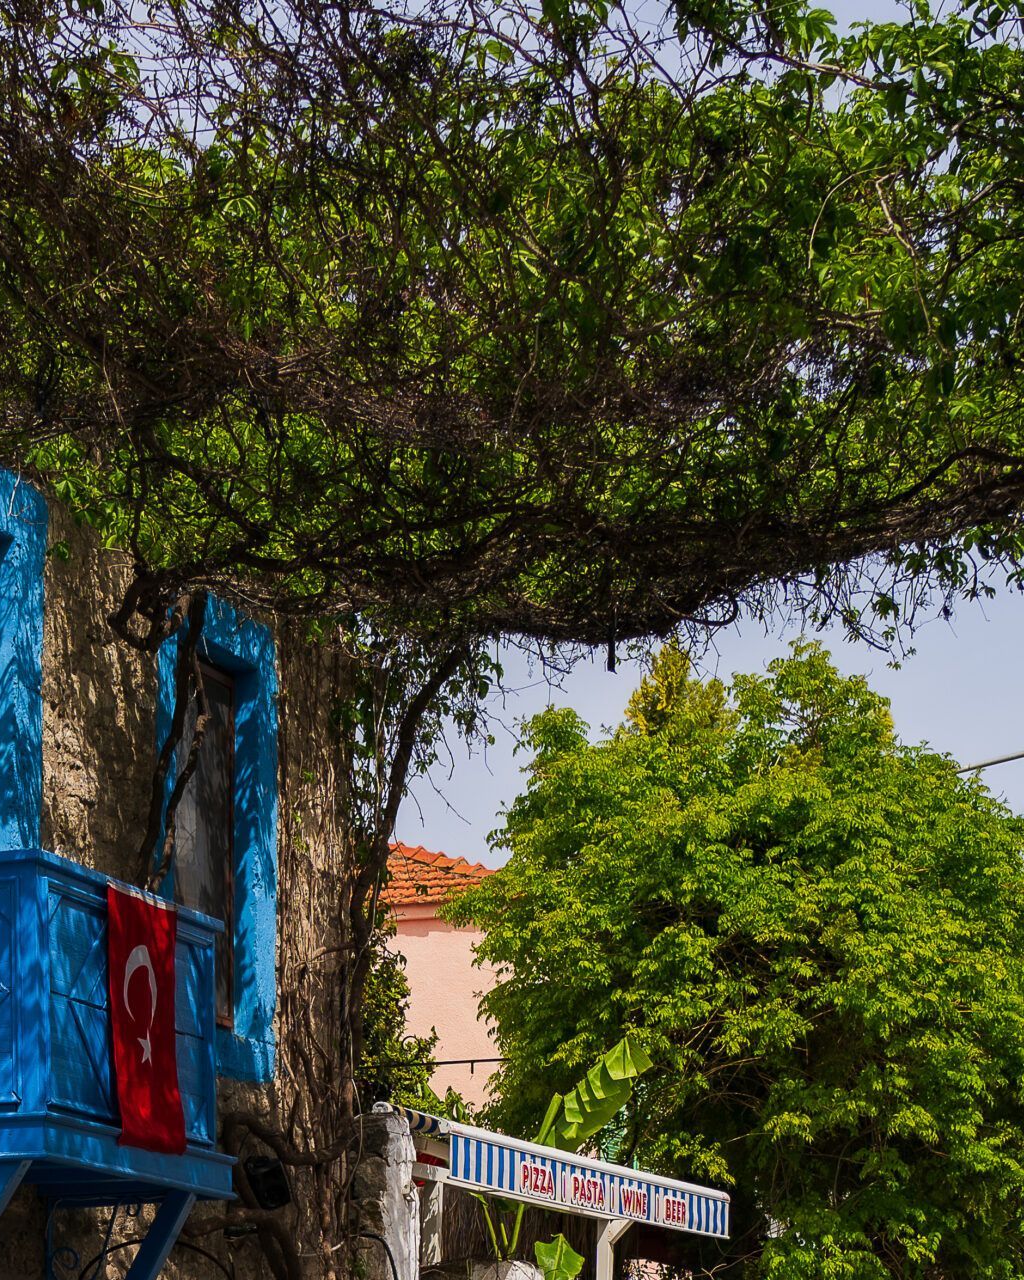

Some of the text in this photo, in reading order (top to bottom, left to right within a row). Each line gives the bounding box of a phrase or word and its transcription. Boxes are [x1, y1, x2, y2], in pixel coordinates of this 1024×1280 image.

[572, 1175, 605, 1208] PASTA
[621, 1186, 647, 1216] WINE
[664, 1197, 686, 1225] BEER
